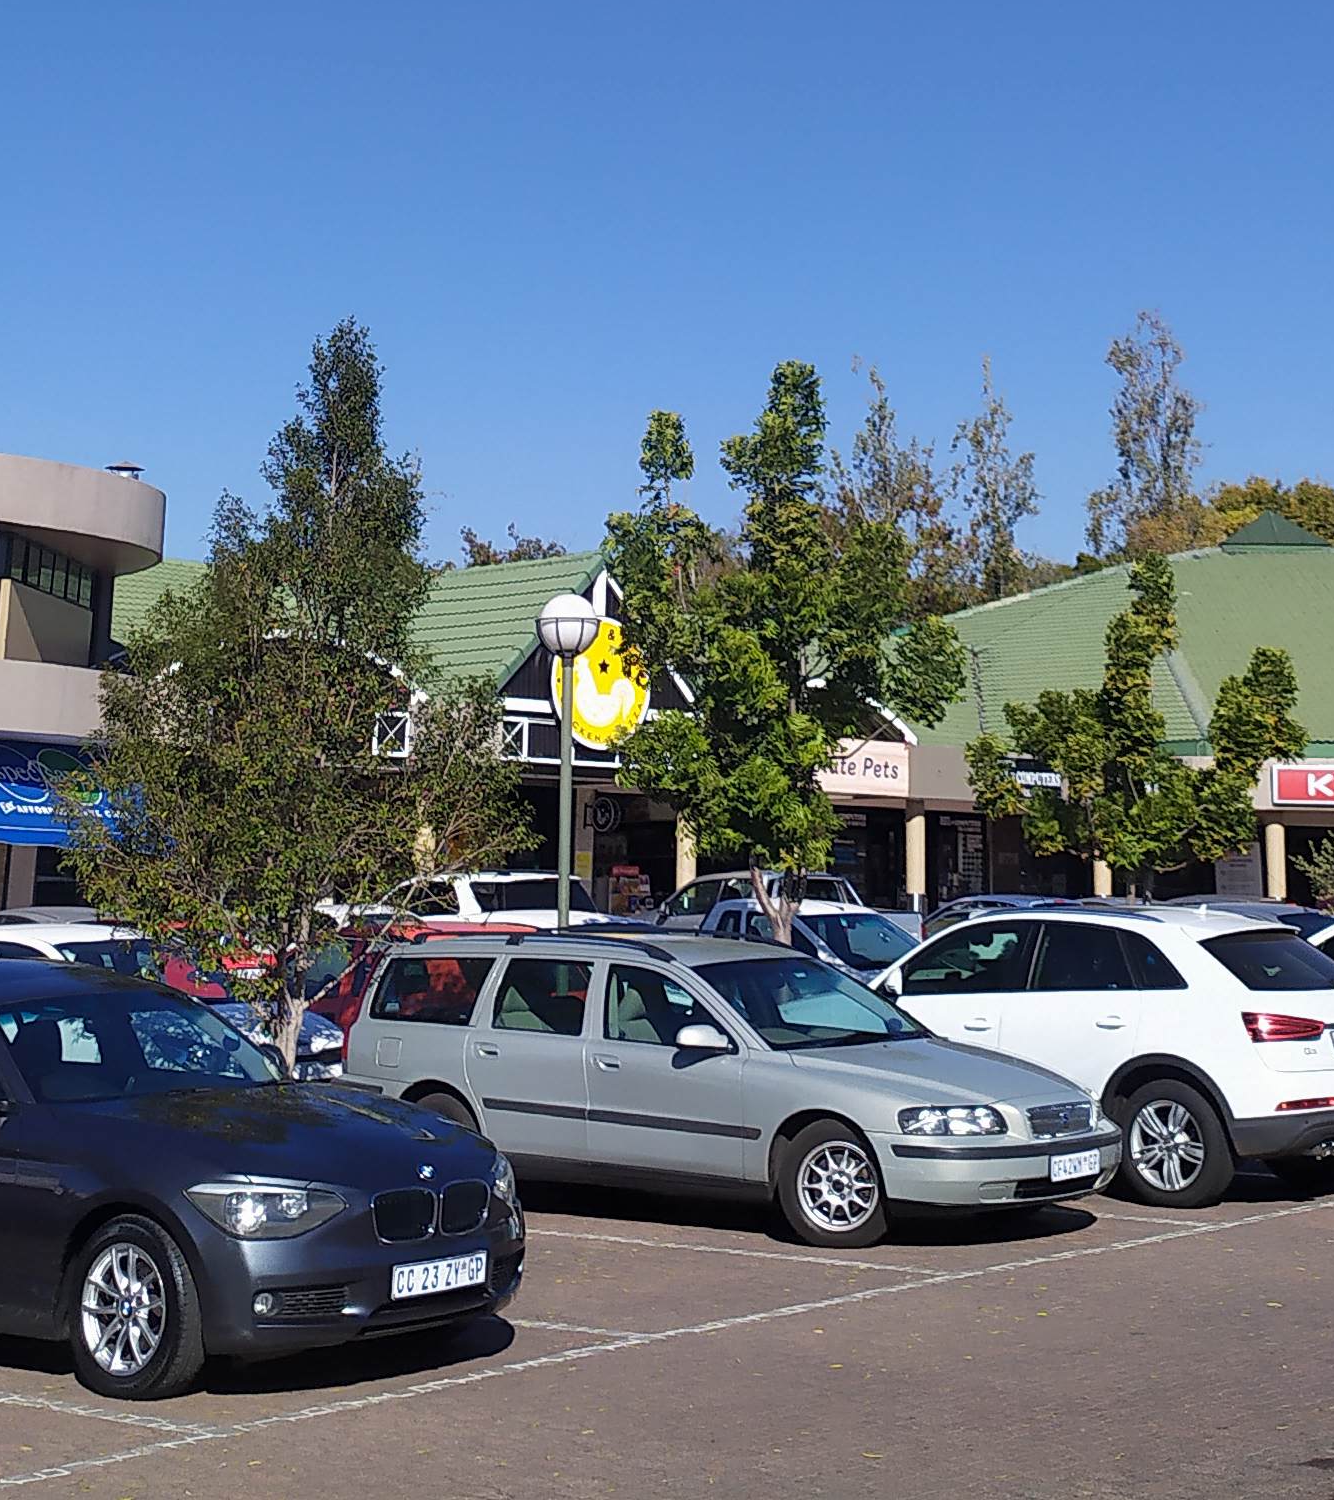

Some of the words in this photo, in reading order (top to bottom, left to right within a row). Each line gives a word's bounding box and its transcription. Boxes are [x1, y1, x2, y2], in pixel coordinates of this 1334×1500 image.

[862, 757, 899, 779] Pets
[396, 1268, 415, 1294] CC
[421, 1264, 440, 1291] 23
[445, 1261, 461, 1287] ZY
[468, 1256, 484, 1282] GP
